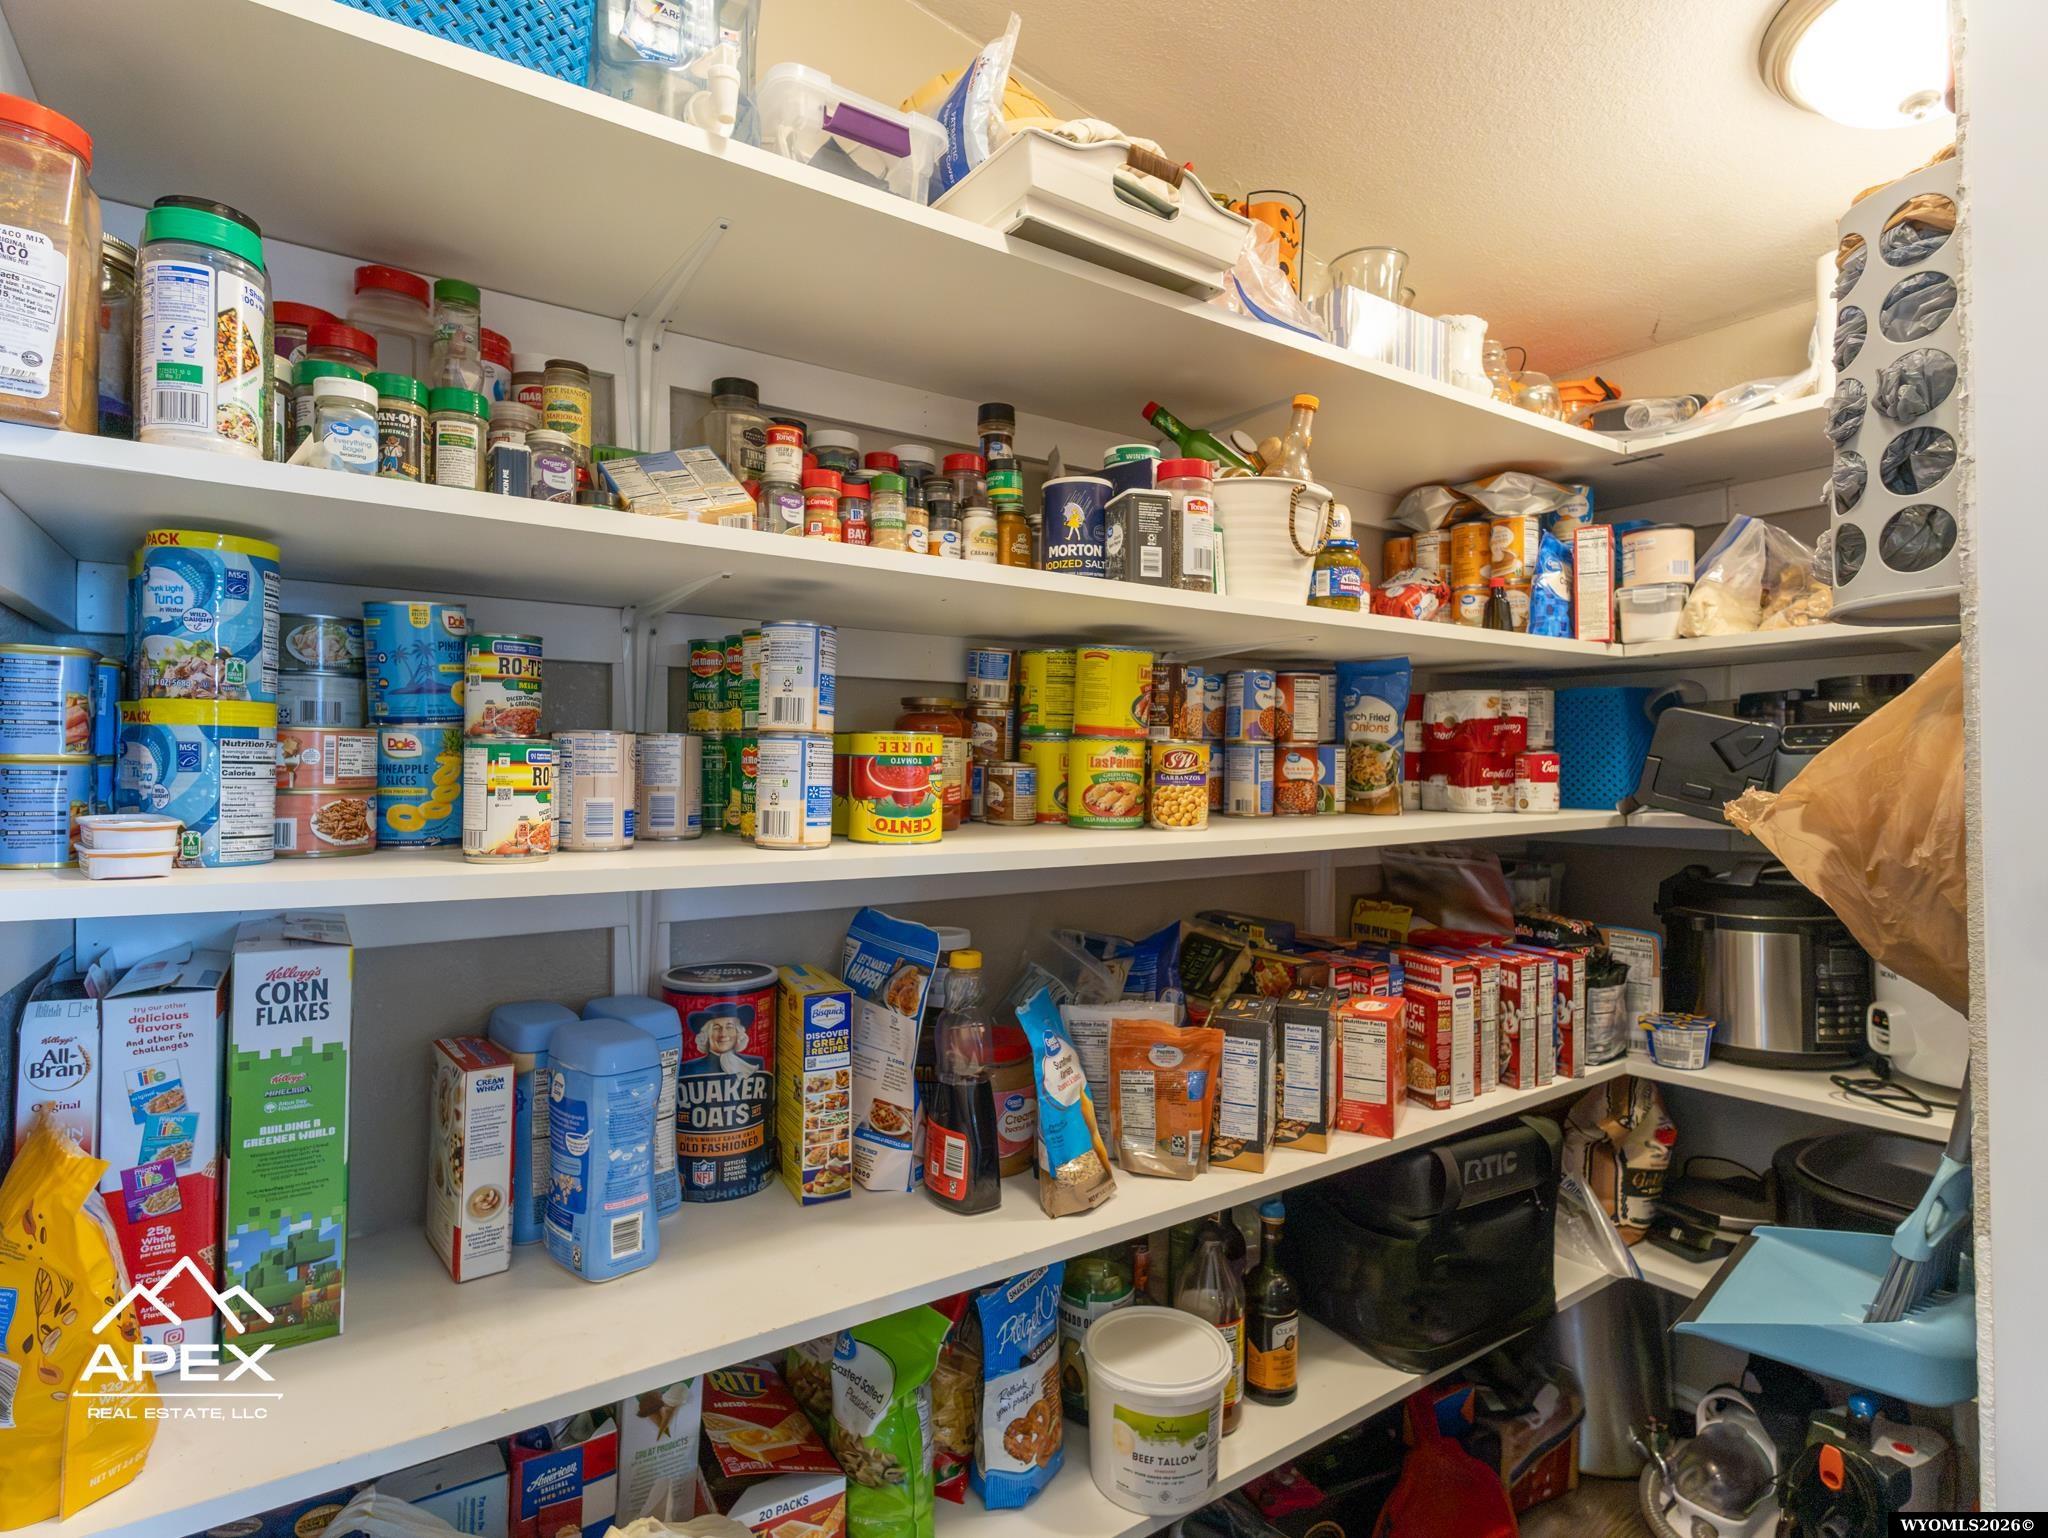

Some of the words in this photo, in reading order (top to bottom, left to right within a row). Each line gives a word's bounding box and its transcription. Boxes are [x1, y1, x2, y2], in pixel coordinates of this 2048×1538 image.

[26, 234, 45, 245] MIX
[333, 437, 373, 449] Everything
[339, 451, 367, 460] Seasoning
[342, 445, 364, 454] Bagel
[542, 458, 567, 468] Organic
[848, 528, 867, 540] BAY
[1048, 544, 1103, 558] MORTON
[1045, 559, 1083, 571] IODIZED
[1084, 559, 1105, 569] SALT
[228, 571, 247, 580] MSC
[164, 585, 184, 594] Light
[154, 593, 184, 606] Tuna
[183, 616, 213, 624] CAUGHT
[447, 615, 465, 628] Dole
[700, 657, 723, 667] Monte
[518, 682, 538, 690] Mild
[694, 693, 718, 701] WHOLE
[1828, 702, 1860, 713] NINJA
[1369, 713, 1390, 722] Fried
[1350, 722, 1389, 733] Onions
[179, 743, 198, 751] MSC
[222, 740, 265, 748] Nutrition
[387, 738, 416, 749] Dole
[878, 741, 934, 753] PUREE
[1090, 757, 1109, 768] Las
[222, 769, 256, 777] Calories
[378, 764, 429, 774] PINEAPPLE
[1482, 768, 1514, 778] Campbell's
[386, 776, 417, 785] SLICES
[875, 817, 932, 833] CENTO
[265, 966, 321, 981] Kellogg's
[848, 963, 886, 990] HAPPEN
[255, 978, 329, 1005] CORN
[128, 1012, 189, 1024] delicious
[256, 1002, 330, 1026] FLAKES
[812, 1008, 844, 1019] Bisquick
[135, 1023, 182, 1033] flavors
[1344, 1018, 1369, 1027] Nutrition
[126, 1039, 144, 1048] And
[147, 1035, 175, 1045] other
[178, 1031, 194, 1040] fun
[806, 1029, 849, 1040] DISCOVER
[813, 1036, 849, 1048] GREAT
[1225, 1038, 1244, 1046] Nutrition
[132, 1041, 189, 1056] challenges
[812, 1045, 849, 1056] RECIPES
[40, 1048, 78, 1064] All-
[30, 1062, 83, 1079] Bran
[137, 1068, 166, 1087] life
[476, 1077, 504, 1087] CREAM
[476, 1084, 504, 1093] WHEAT
[678, 1077, 765, 1108] QUAKER
[31, 1100, 80, 1114] Oginal
[692, 1103, 750, 1128] OATS
[158, 1121, 183, 1137] life
[260, 1119, 311, 1136] BUILDING
[1005, 1122, 1025, 1133] Peanut
[243, 1132, 296, 1149] GREENER
[298, 1127, 336, 1141] WORLD
[680, 1143, 699, 1153] OLD
[702, 1136, 759, 1153] FASHIONED
[724, 1158, 747, 1166] OFFICIAL
[724, 1164, 747, 1172] OATMEAL
[1464, 1151, 1517, 1185] RTIC
[696, 1173, 711, 1184] NFL
[724, 1169, 747, 1178] SPONSOR
[135, 1173, 163, 1190] life
[147, 1225, 172, 1237] 25g
[141, 1234, 175, 1246] Whole
[140, 1242, 176, 1254] Grains
[150, 1247, 176, 1257] serving
[1008, 1278, 1027, 1301] SNACK
[1026, 1265, 1048, 1288] FACTORY
[996, 1295, 1041, 1355] Pretzel
[707, 1371, 768, 1393] RITZ
[861, 1379, 884, 1404] Salted
[999, 1378, 1028, 1402] Rethink
[996, 1401, 1012, 1421] your
[1012, 1380, 1037, 1412] pretzel
[1132, 1451, 1154, 1465] BEEF
[1158, 1453, 1197, 1466] TALLOW
[90, 1473, 107, 1487] NET
[108, 1465, 122, 1479] WT
[527, 1462, 578, 1493] American
[541, 1480, 568, 1494] ORIGINAL
[760, 1508, 773, 1522] 20
[775, 1494, 809, 1516] PACKS
